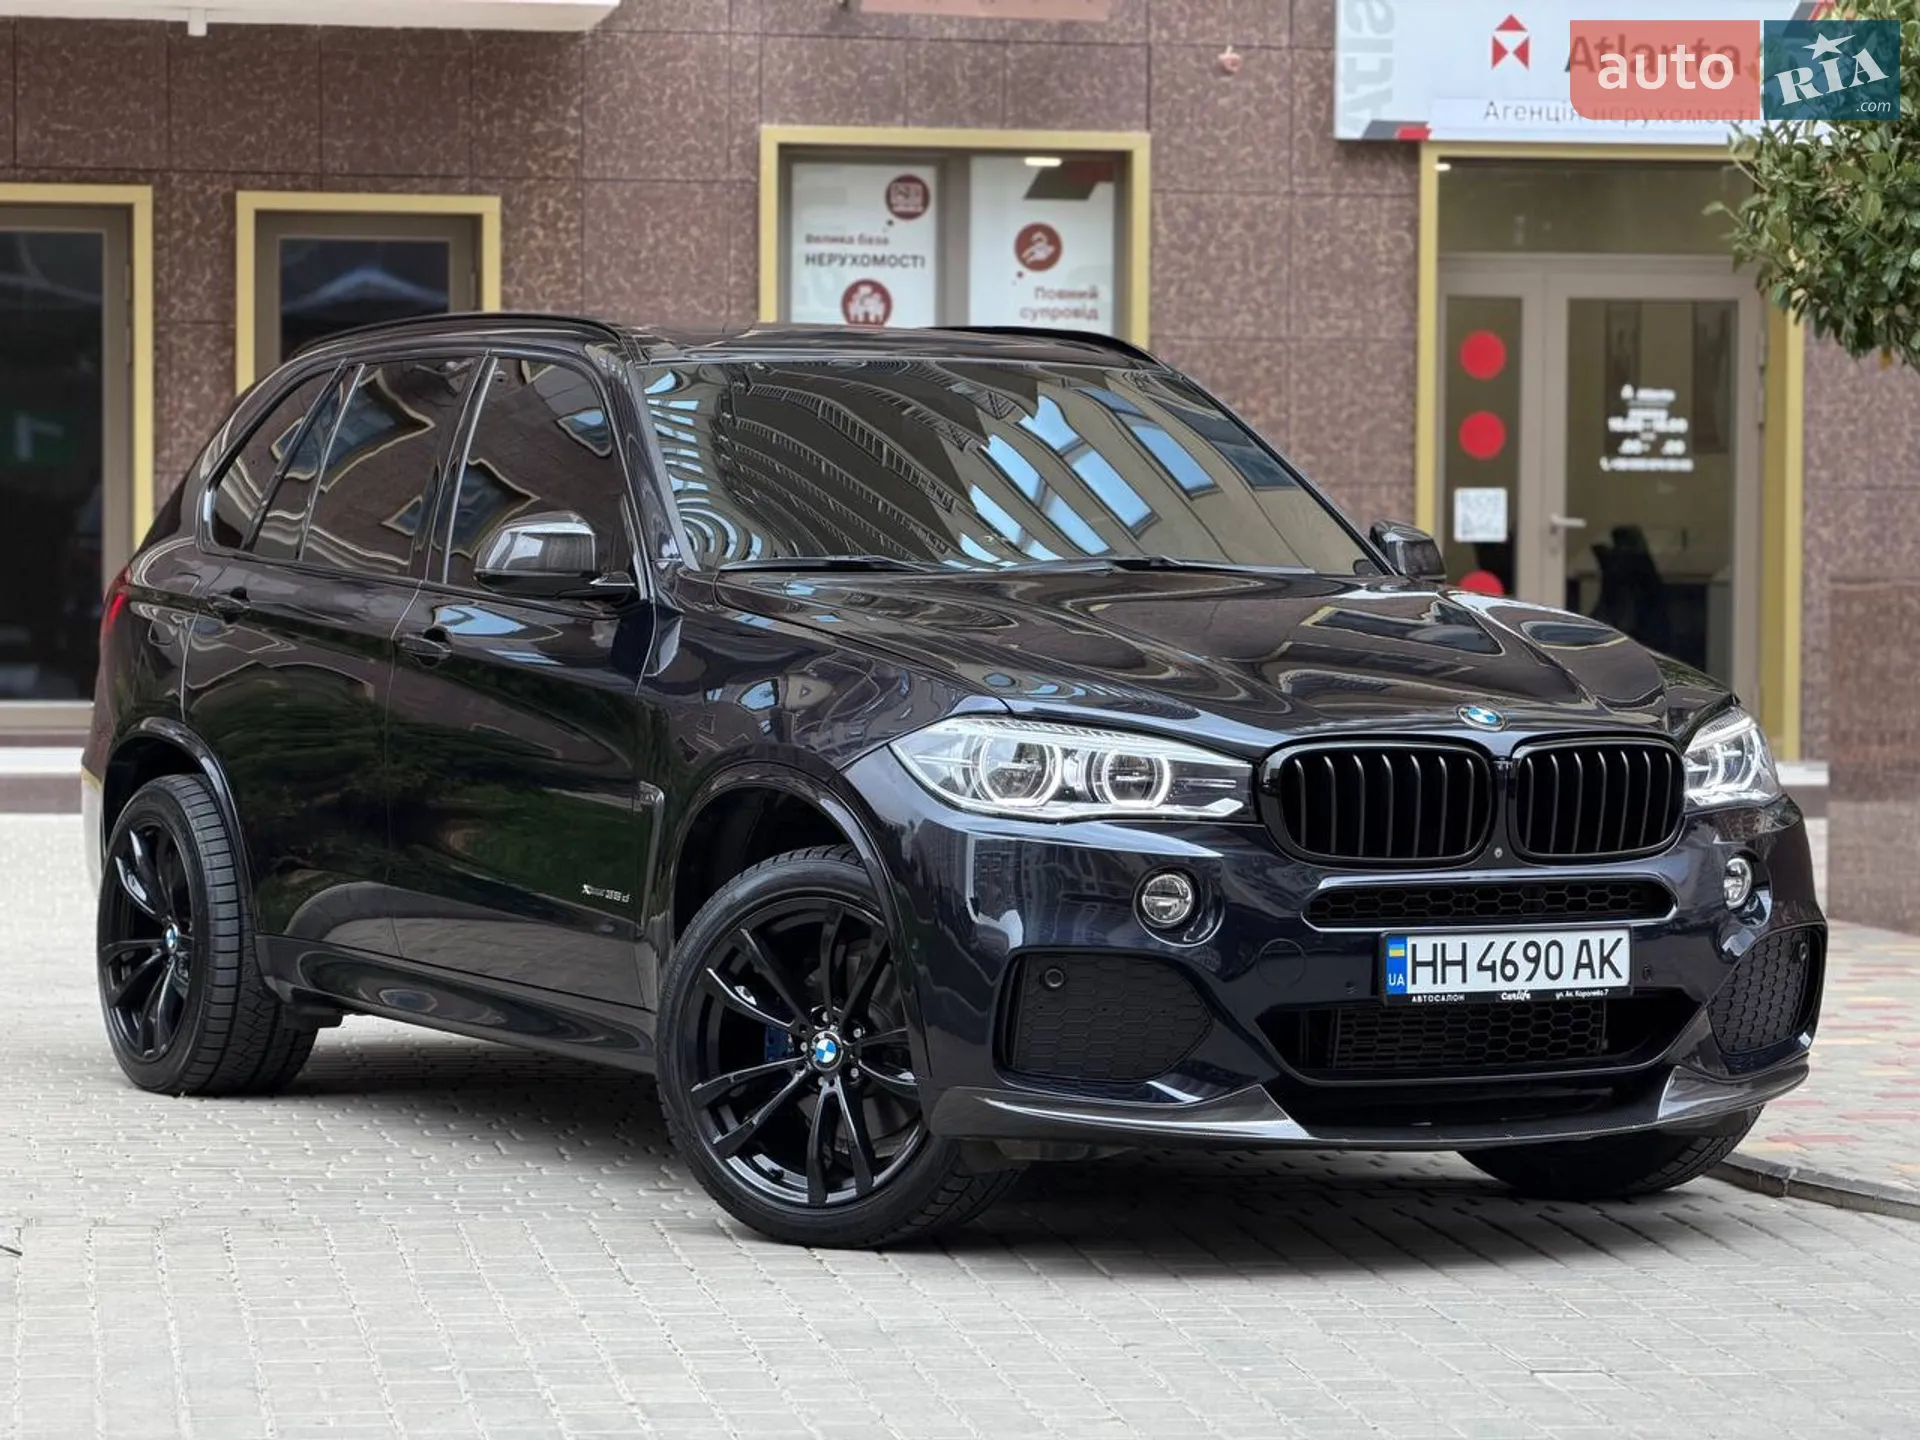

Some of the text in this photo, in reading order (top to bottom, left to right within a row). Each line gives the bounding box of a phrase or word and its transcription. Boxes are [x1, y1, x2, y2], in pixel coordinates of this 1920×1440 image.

[1483, 100, 1581, 123] Агенція
[805, 252, 925, 268] НЕРУХОМОСТІ
[1411, 937, 1623, 985] HH 4690 AK
[1388, 973, 1405, 986] UA
